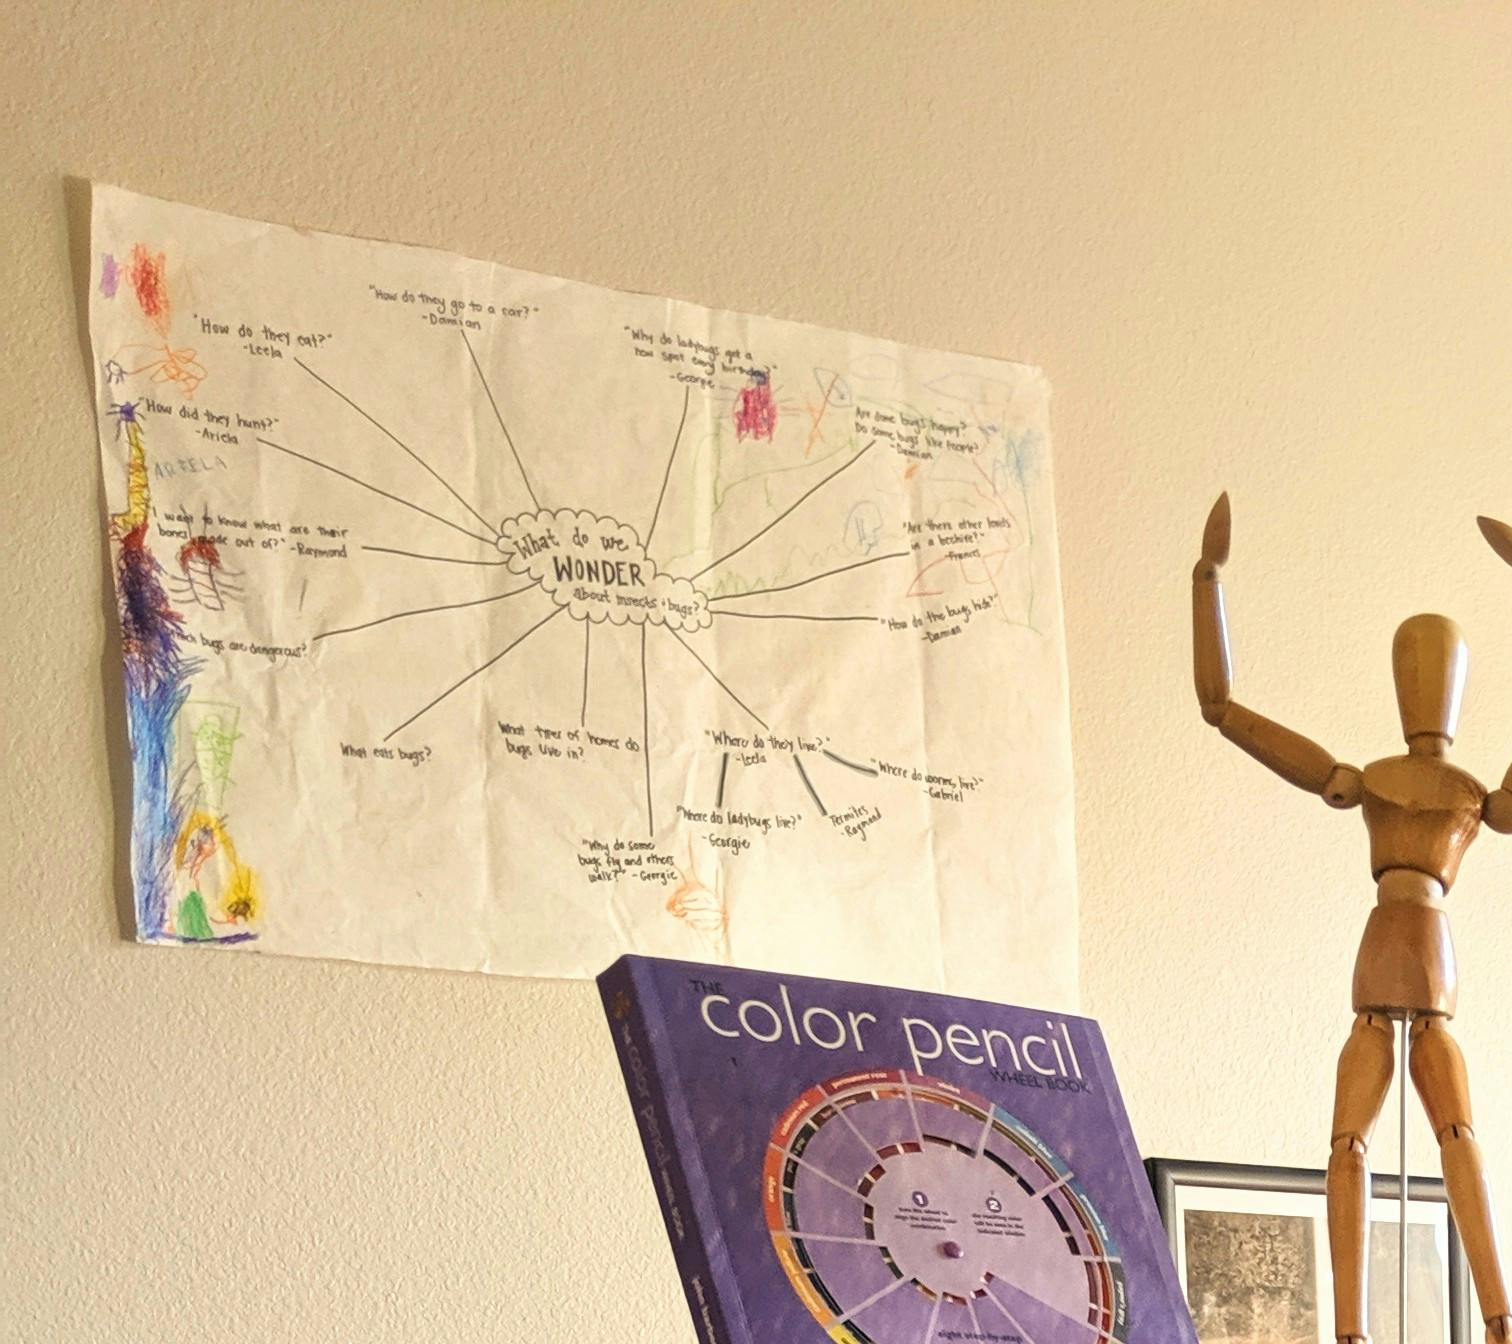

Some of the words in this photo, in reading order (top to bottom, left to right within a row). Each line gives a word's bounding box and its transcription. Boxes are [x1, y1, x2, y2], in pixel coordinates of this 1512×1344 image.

[402, 290, 415, 303] do
[418, 293, 446, 314] they
[451, 300, 465, 316] go
[469, 301, 482, 312] to
[488, 306, 495, 314] a
[238, 324, 253, 337] do
[261, 325, 290, 346] they
[660, 332, 672, 345] do
[179, 406, 199, 419] did
[204, 409, 229, 428] they
[218, 516, 248, 529] know
[253, 521, 282, 532] what
[289, 526, 310, 535] are
[317, 526, 349, 538] their
[235, 539, 255, 548] out
[513, 528, 560, 560] What
[573, 527, 588, 547] do
[601, 535, 629, 551] we
[553, 555, 645, 586] WONDER
[573, 587, 610, 603] about
[668, 598, 700, 619] bugs?
[927, 611, 945, 623] the
[567, 729, 579, 741] of
[625, 737, 640, 752] do
[753, 734, 764, 748] do
[767, 736, 793, 752] they
[340, 742, 367, 759] What
[398, 745, 432, 767] bugs?
[911, 768, 922, 781] do
[710, 811, 723, 824] do
[727, 811, 772, 835] ladybugs
[614, 839, 625, 850] do
[628, 840, 655, 851] some
[624, 855, 642, 866] and
[646, 853, 674, 866] others
[689, 979, 724, 995] THE
[701, 983, 877, 1052] color
[902, 1017, 1083, 1079] pencil
[989, 1069, 1043, 1090] WHEEL
[1043, 1074, 1091, 1094] BOOK
